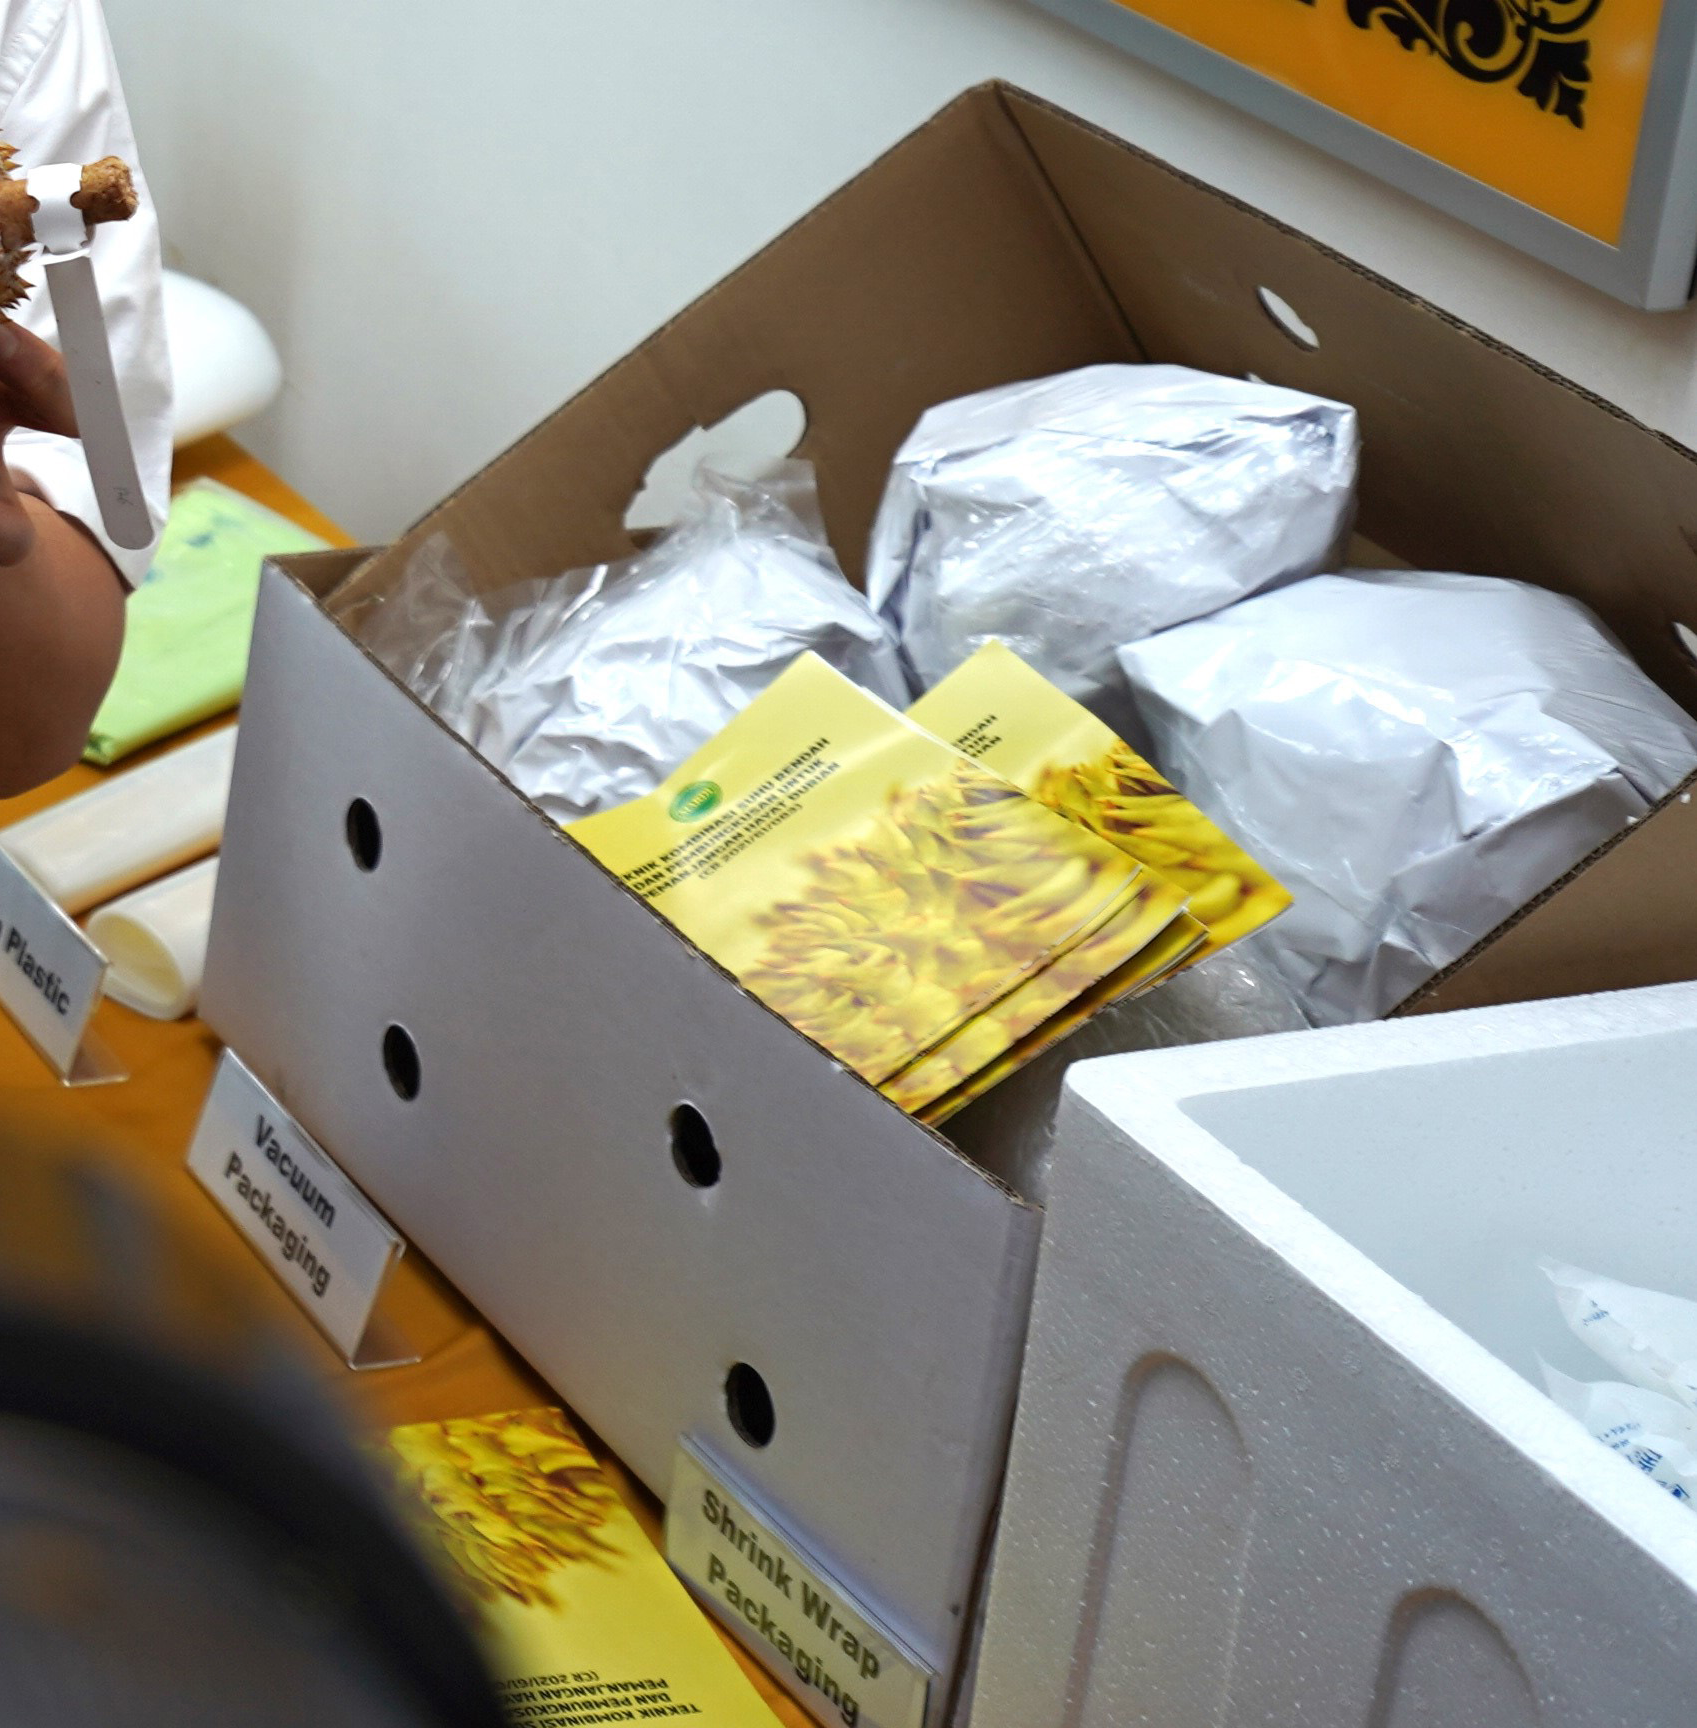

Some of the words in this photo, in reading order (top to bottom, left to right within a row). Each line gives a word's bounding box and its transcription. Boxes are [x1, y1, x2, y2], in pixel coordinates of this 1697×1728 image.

[633, 871, 666, 892] DAN
[665, 794, 779, 874] PEMBUNGKUSAN
[777, 758, 826, 794] UNTUK
[658, 809, 738, 864] KOMBINASI
[736, 780, 775, 811] SUHU
[773, 737, 831, 782] RENDAH
[743, 800, 788, 833] HAYAT
[788, 760, 842, 802] DURIAN
[4, 929, 73, 1019] Plastic
[254, 1112, 339, 1229] Vacuum
[223, 1150, 332, 1301] Packaging
[702, 1487, 793, 1600] Shrink
[801, 1581, 881, 1681] Wrap
[570, 1668, 601, 1684] (CR
[707, 1552, 860, 1728] Packaging
[510, 1696, 634, 1719] PEMBUNGKUS
[539, 1678, 671, 1702] PEMANJANGAN
[635, 1692, 672, 1706] DAN
[637, 1702, 703, 1719] TEKNIK
